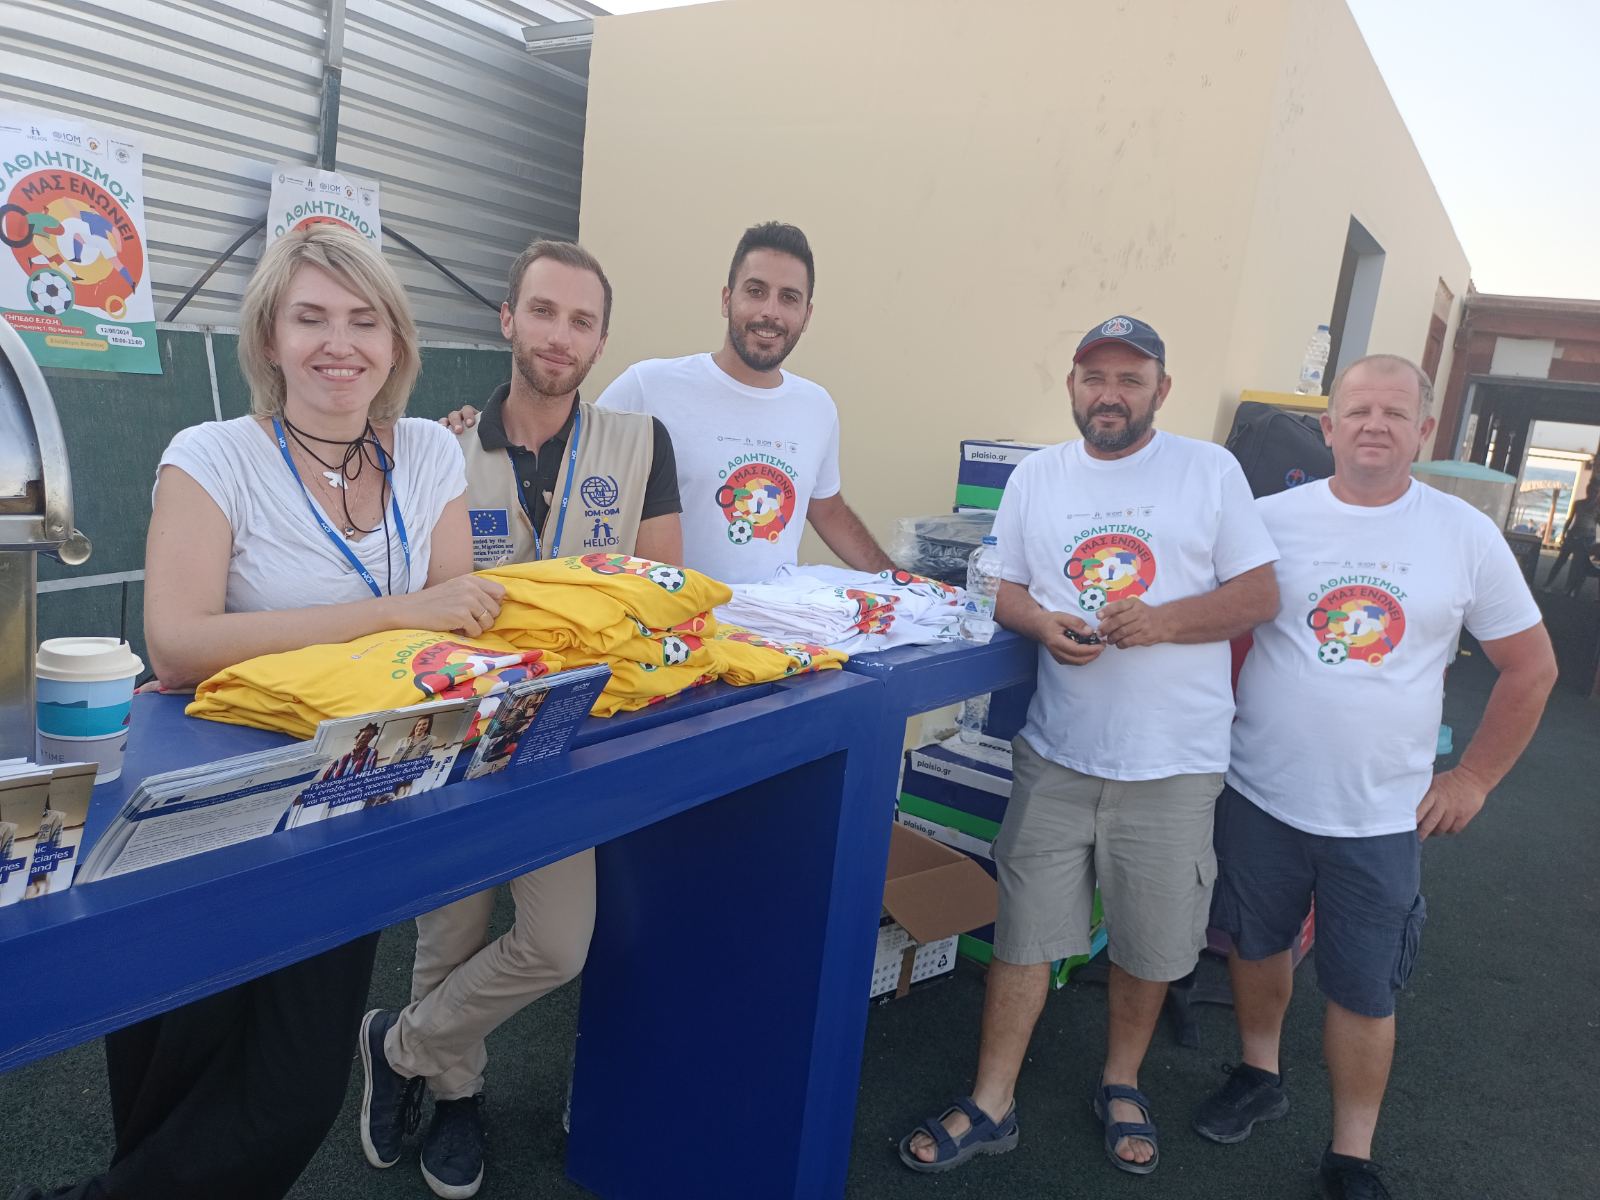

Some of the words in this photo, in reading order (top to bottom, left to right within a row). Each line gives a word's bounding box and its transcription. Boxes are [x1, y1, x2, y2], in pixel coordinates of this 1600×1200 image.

[63, 131, 81, 143] IOM
[3, 150, 135, 210] ΑΘΛΗΤΙΣΜΟΣ
[21, 174, 65, 201] ΜΑΣ
[69, 177, 135, 241] ΕΝΩΝΕΙ
[275, 224, 285, 237] Ο
[285, 200, 377, 239] ΑΘΛΗΤΙΣΜΟΣ
[718, 469, 727, 479] Ο
[727, 452, 799, 481] ΑΘΛΗΤΙΣΜΟΣ
[971, 451, 1008, 461] plaisio.gr
[734, 466, 760, 483] ΜΑΣ
[760, 466, 793, 500] ΕΝΩΝΕΙ
[583, 536, 619, 548] HELIOS
[1063, 544, 1073, 553] Ο
[1073, 524, 1153, 543] ΑΘΛΗΤΙΣΜΟΣ
[1080, 536, 1108, 554] ΜΑΣ
[1110, 536, 1151, 562] ΕΝΩΝΕΙ
[1308, 592, 1318, 602] Ο
[1319, 575, 1408, 602] ΑΘΛΗΤΙΣΜΟΣ
[1327, 588, 1357, 605] ΜΑΣ
[1359, 587, 1401, 621] ΕΝΩΝΕΙ
[391, 669, 408, 680] Ο
[355, 766, 387, 779] HELIOS
[916, 759, 951, 775] plaisio.gr
[903, 820, 936, 836] plaisio.gr
[30, 861, 52, 874] and
